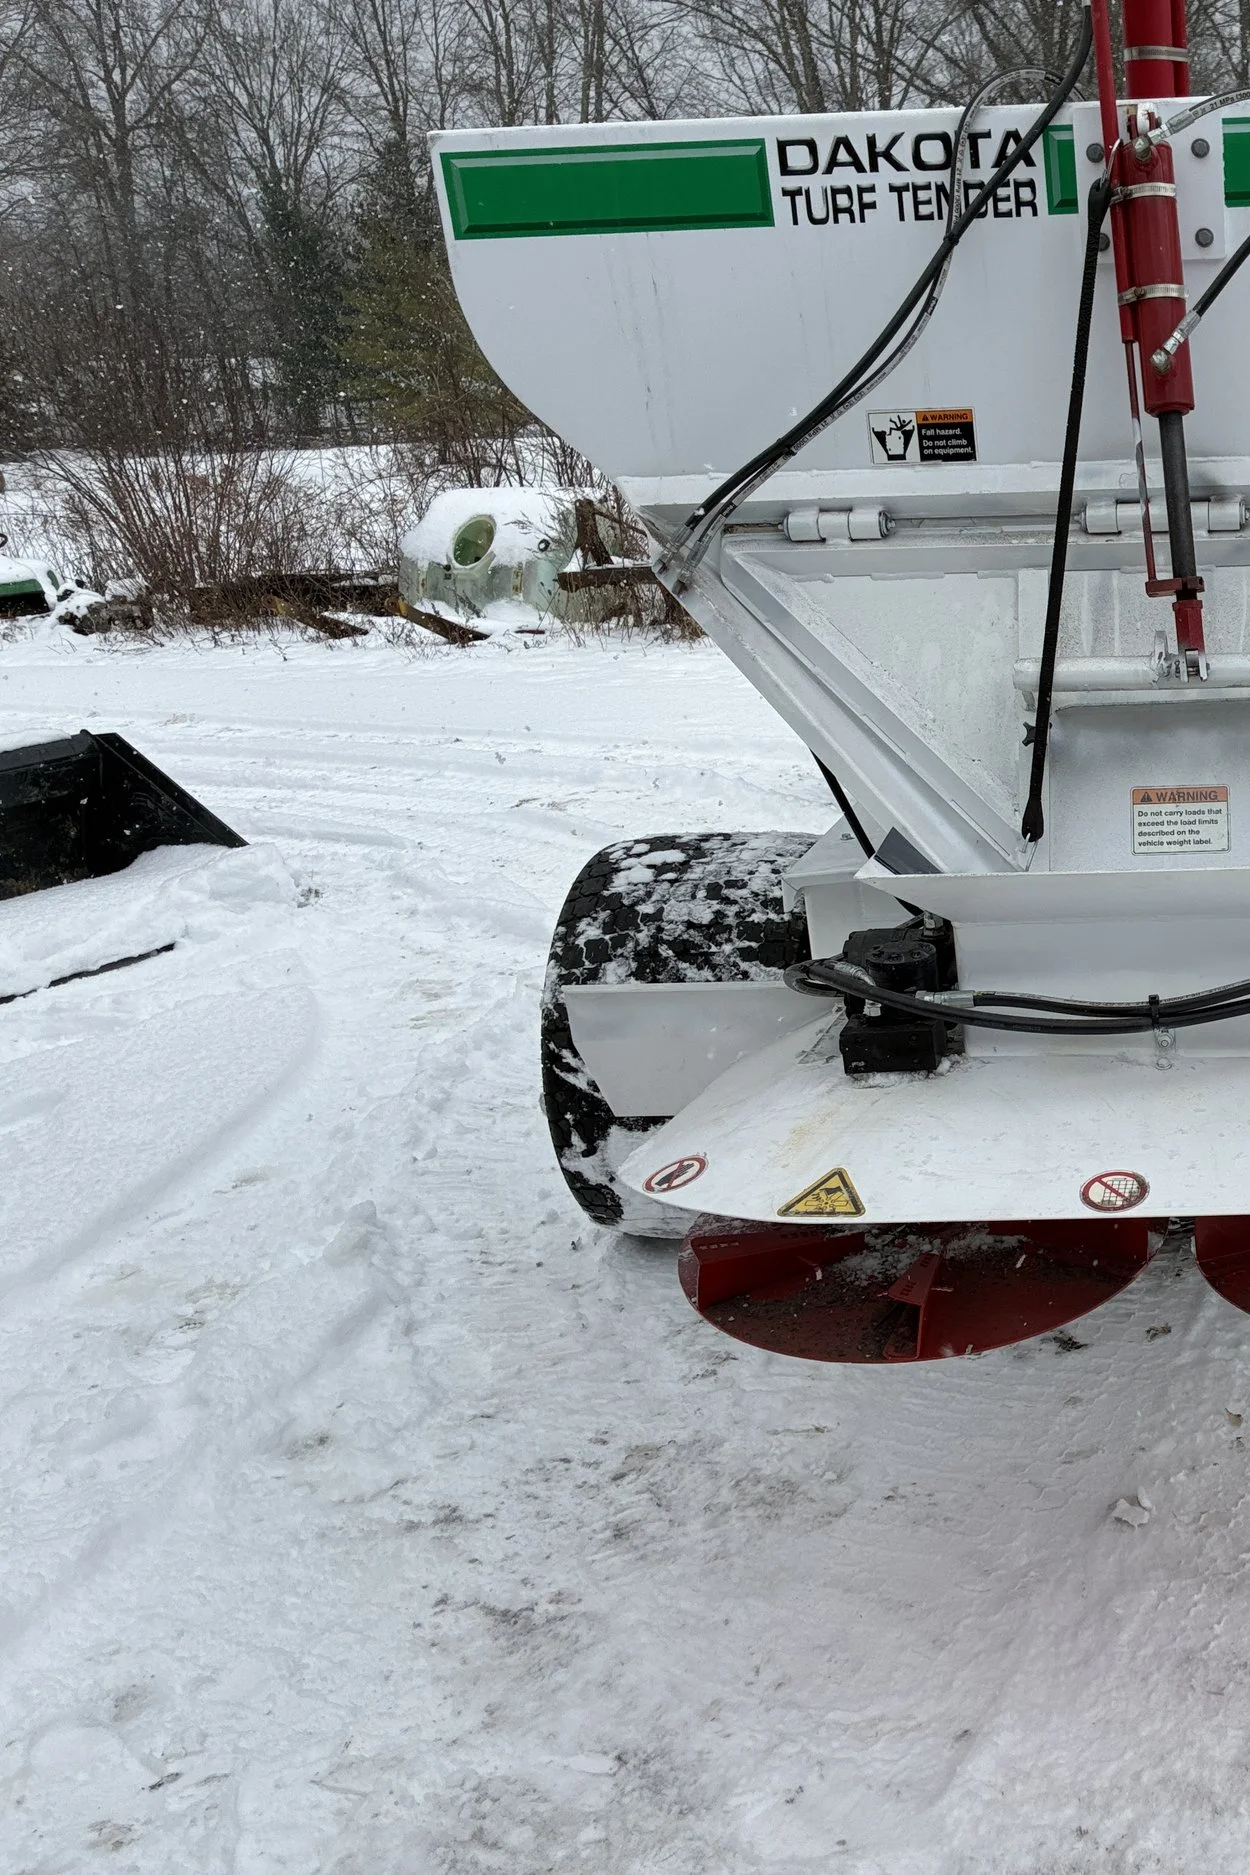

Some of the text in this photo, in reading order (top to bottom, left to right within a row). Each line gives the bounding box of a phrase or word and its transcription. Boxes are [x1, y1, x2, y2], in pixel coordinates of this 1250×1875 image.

[776, 128, 1037, 177] DAKOTA
[781, 177, 1038, 226] TURF TENDER
[929, 413, 969, 421] WARNING
[921, 427, 962, 436] Fall hazard.
[934, 447, 974, 456] equipment.
[1155, 790, 1218, 802] WARNING
[1164, 809, 1184, 818] carry
[1185, 808, 1206, 816] loads
[1137, 819, 1165, 827] exceed
[1137, 829, 1175, 837] described
[1137, 839, 1165, 847] vehicle
[1166, 838, 1192, 847] weight
